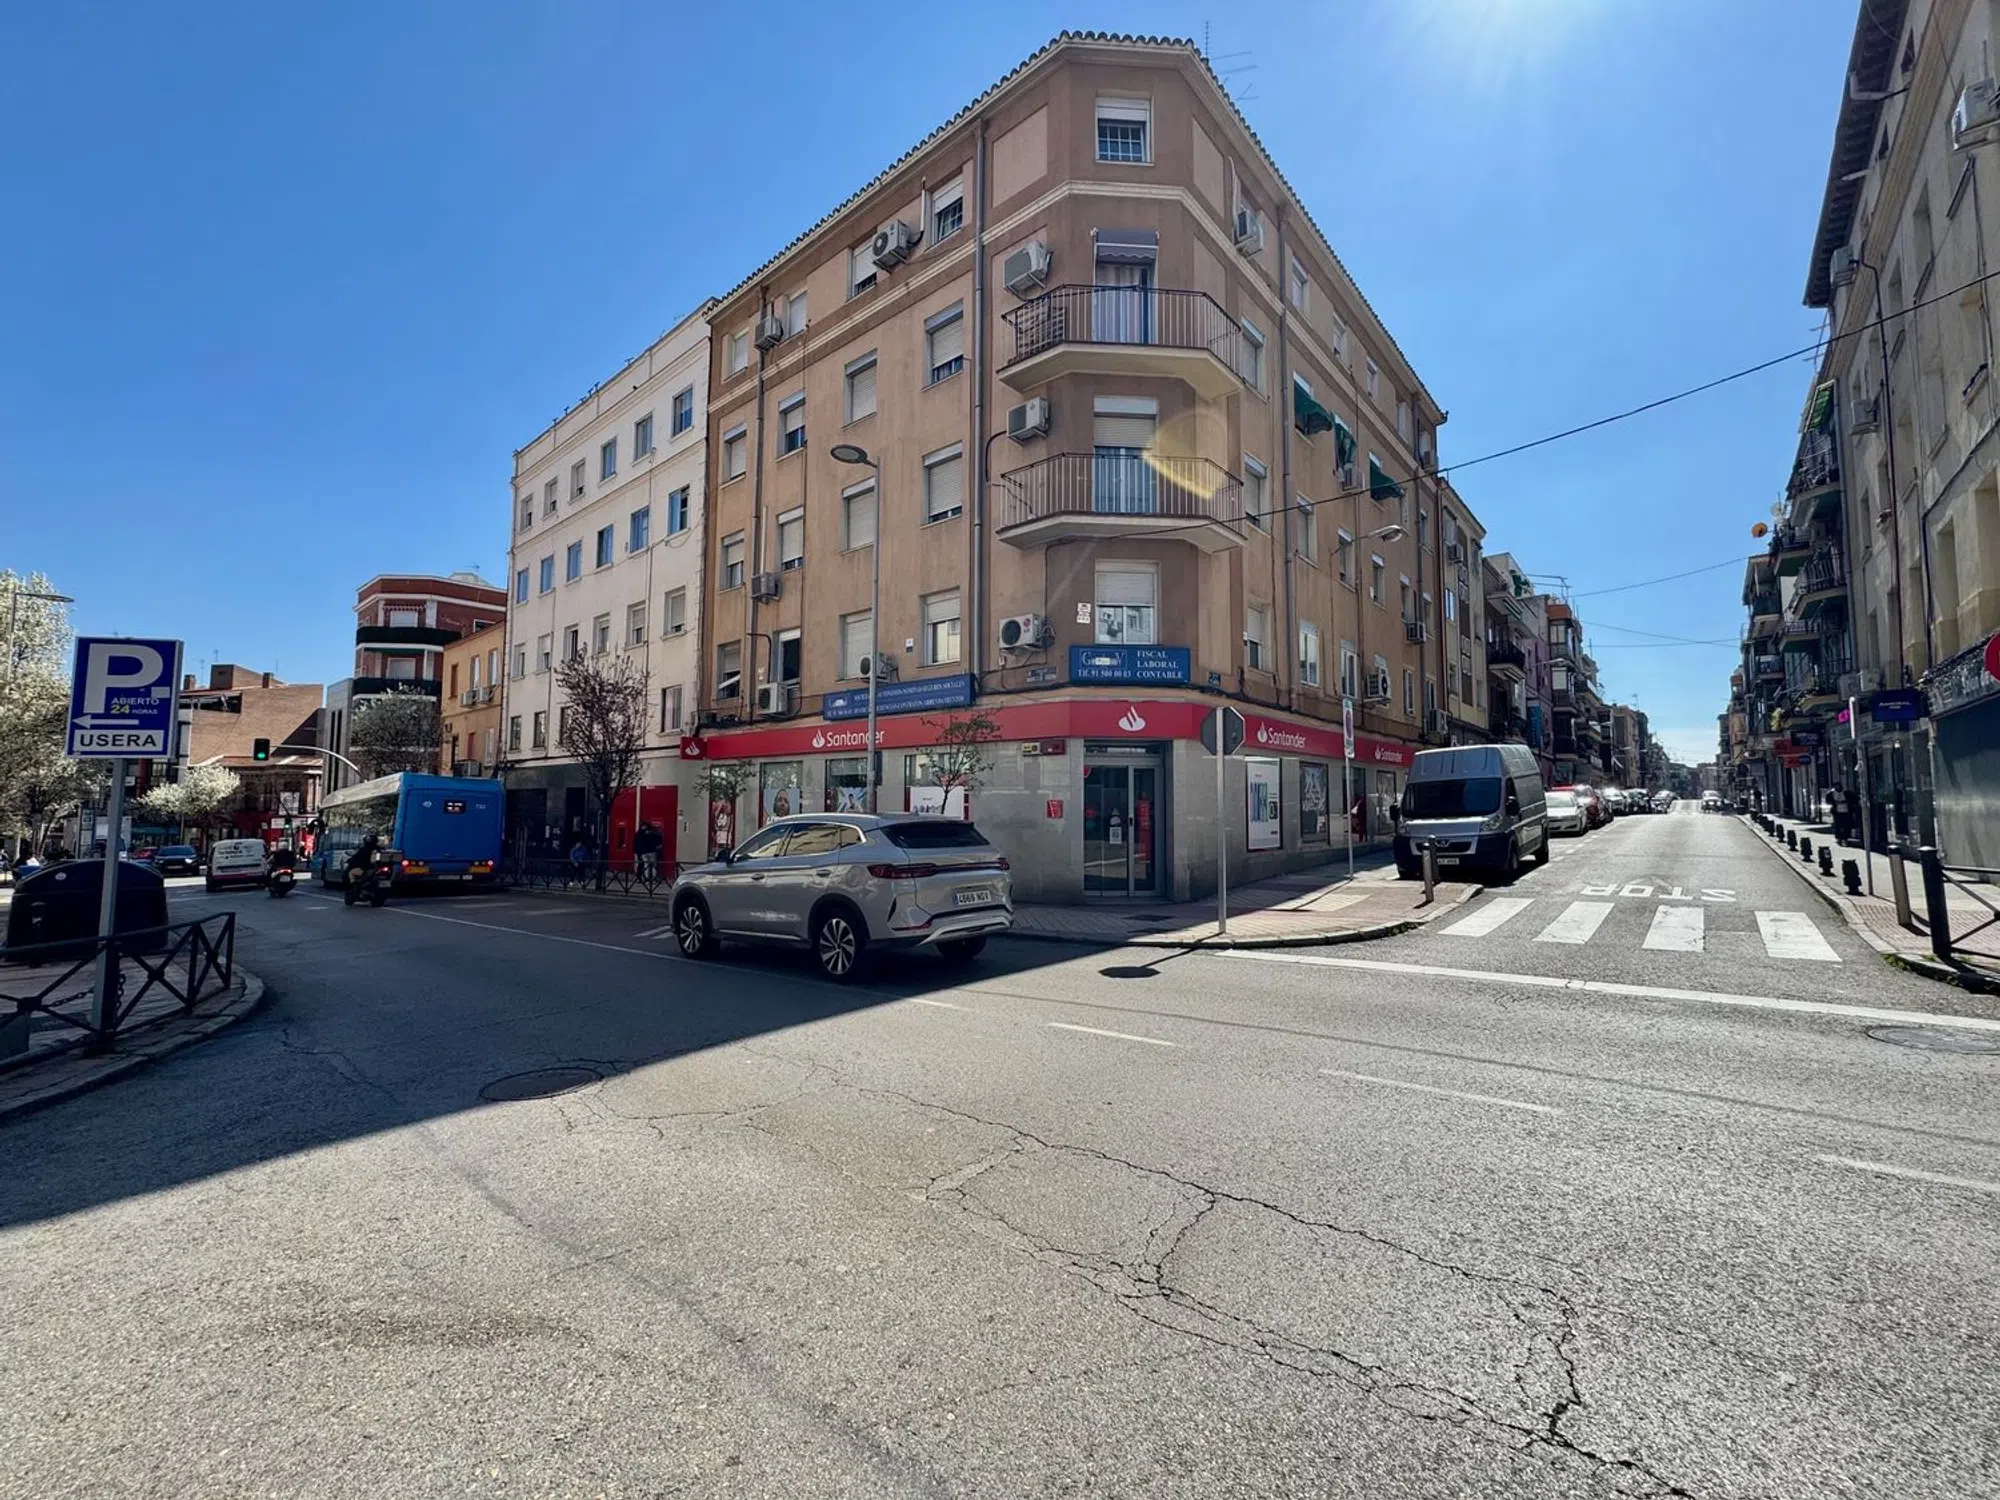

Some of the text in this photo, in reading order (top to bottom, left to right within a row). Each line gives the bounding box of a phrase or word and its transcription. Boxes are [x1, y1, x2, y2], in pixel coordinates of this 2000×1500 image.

[1136, 650, 1168, 659] FISCAL
[1136, 660, 1179, 669] LABORAL
[83, 643, 163, 713] P
[1136, 670, 1183, 679] CONTABLE
[111, 697, 160, 706] ABIERTO
[110, 705, 131, 715] 24
[80, 733, 157, 747] USERA
[1268, 727, 1306, 748] Santander
[1579, 884, 1738, 902] STOP
